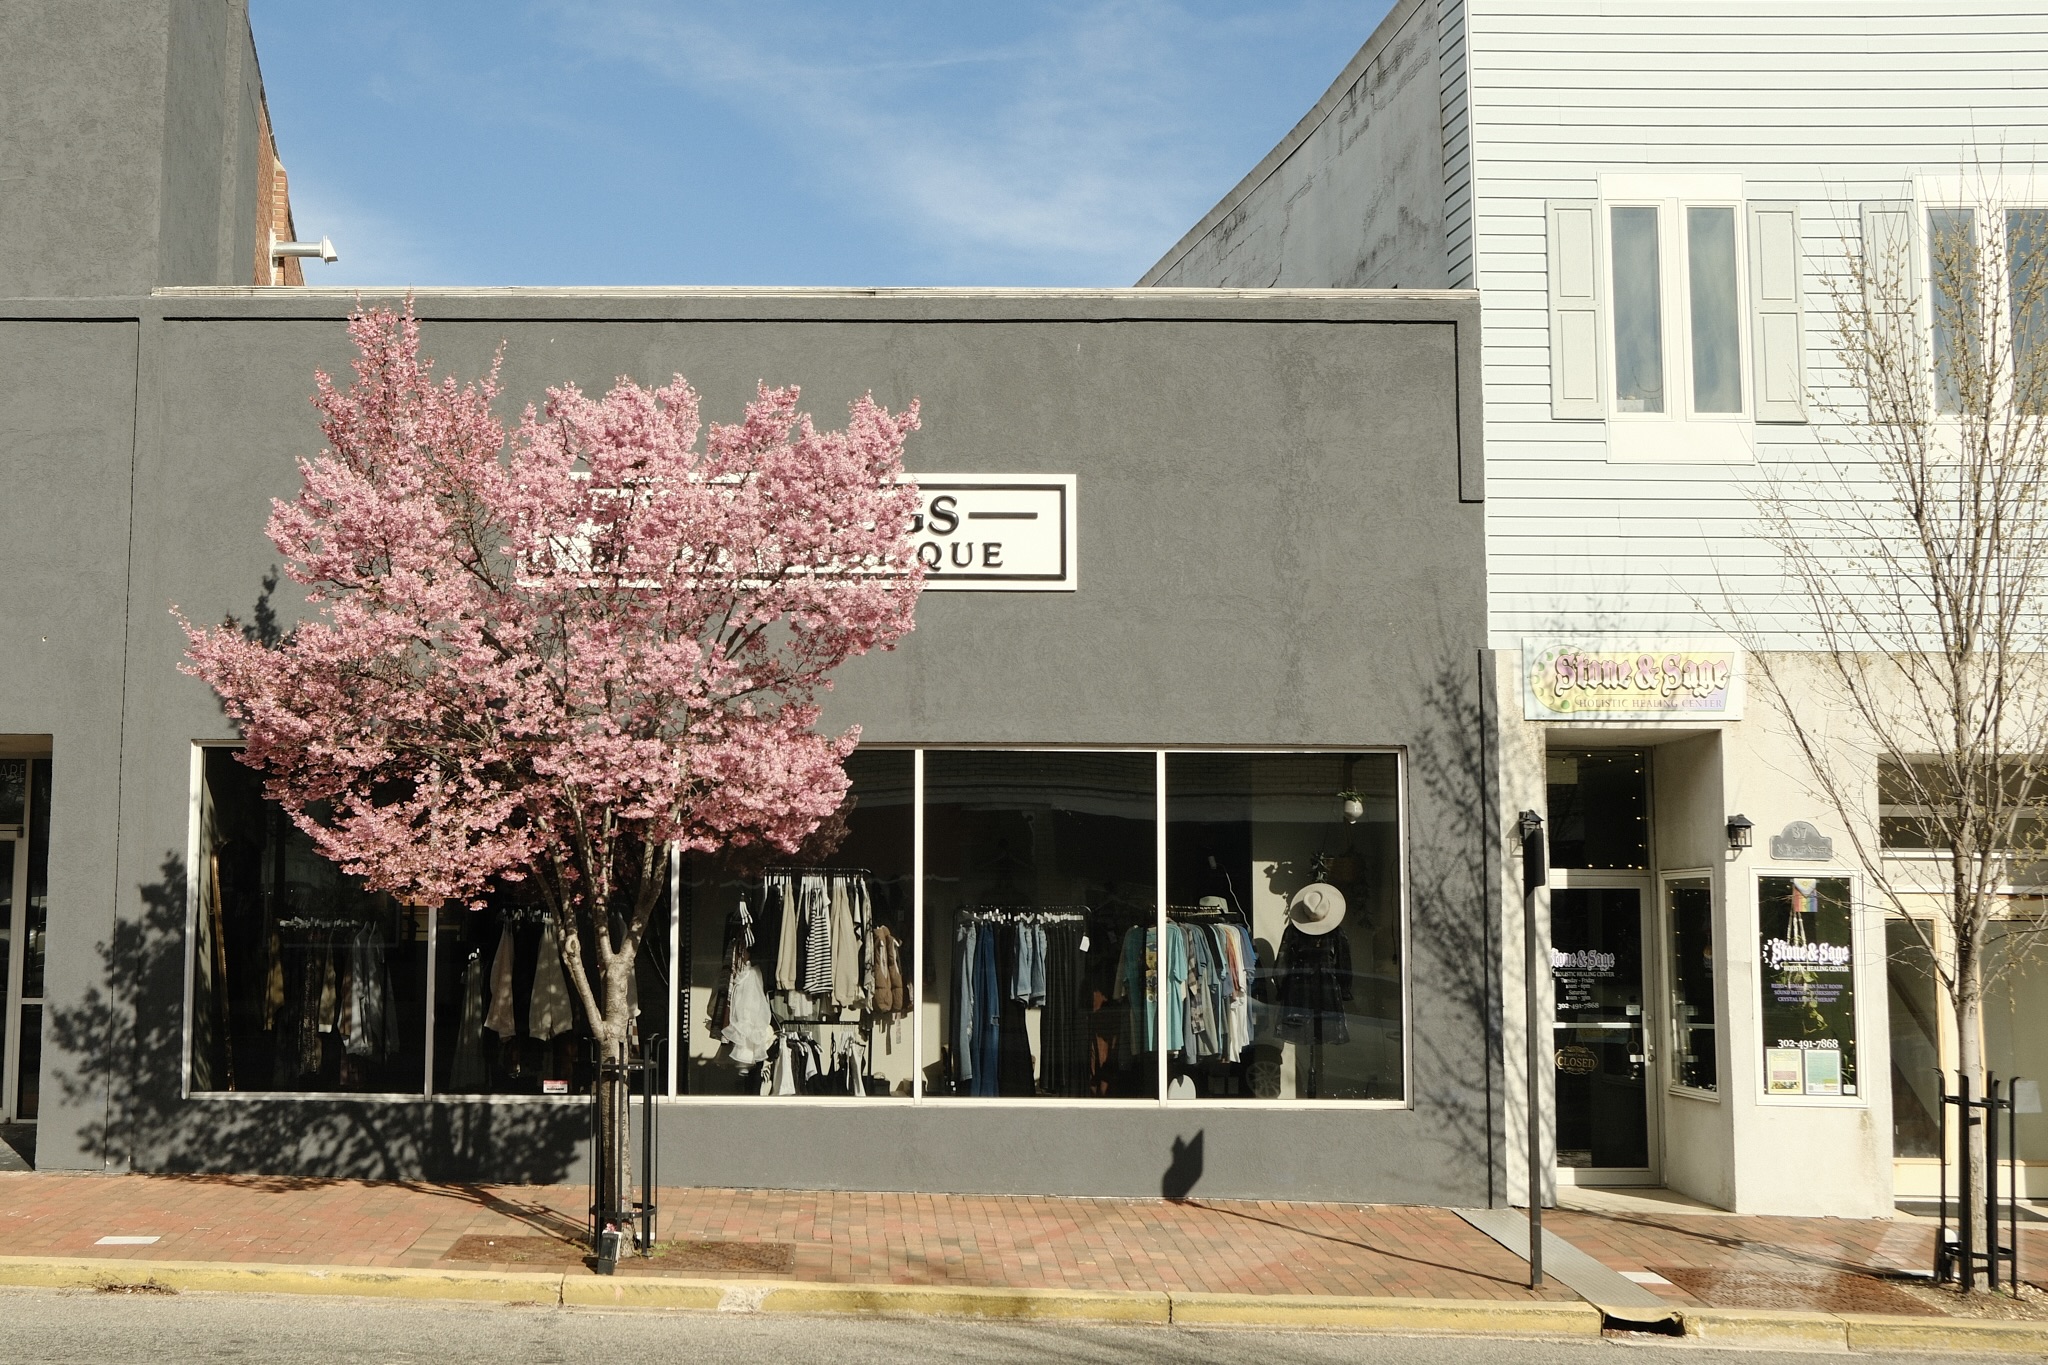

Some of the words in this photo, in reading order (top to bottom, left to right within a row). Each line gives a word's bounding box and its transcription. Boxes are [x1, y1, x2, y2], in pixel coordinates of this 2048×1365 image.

[1555, 653, 1632, 697] Stone
[1634, 654, 1660, 690] &
[1661, 653, 1729, 698] Sage
[1579, 699, 1628, 708] HOLISTIC
[1632, 699, 1678, 708] HEALING
[1682, 699, 1722, 708] CENTER
[1577, 950, 1587, 967] &
[1587, 949, 1615, 971] Sage
[1771, 942, 1807, 964] Stone
[1807, 943, 1819, 961] &
[1819, 942, 1850, 965] Sage
[1777, 1039, 1839, 1050] 302-491-7868
[1557, 1056, 1595, 1068] CLOSED
